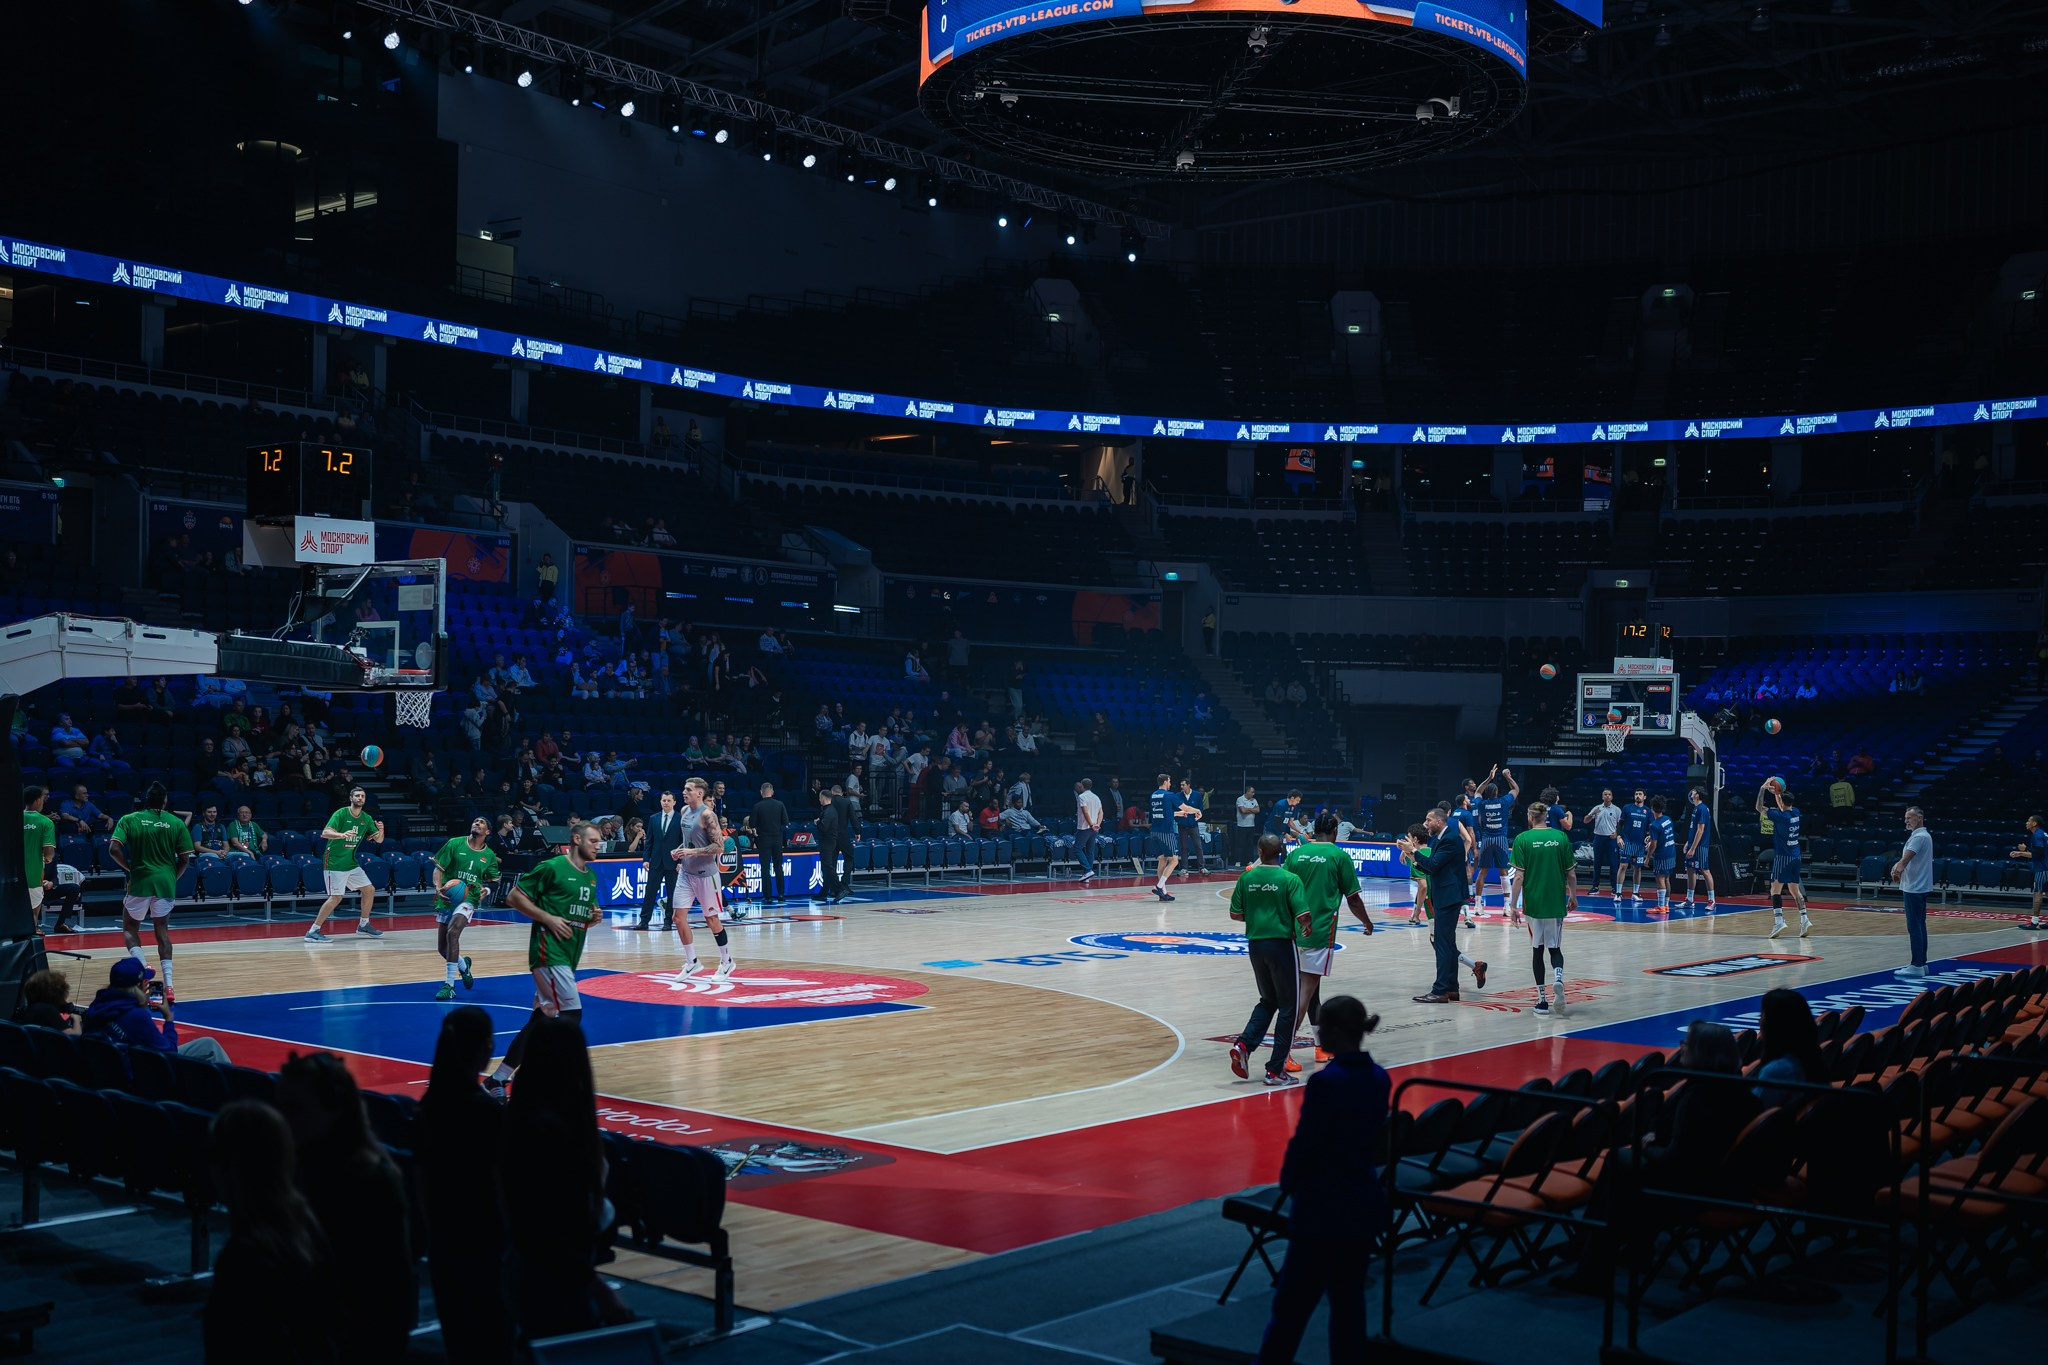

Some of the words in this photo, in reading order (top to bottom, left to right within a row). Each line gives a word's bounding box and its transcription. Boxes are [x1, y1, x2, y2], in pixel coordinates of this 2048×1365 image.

[940, 14, 947, 33] 0
[965, 0, 1114, 43] TICKETS.VTB-LEAGUE.COM
[13, 242, 65, 261] МОСКОВСКИЙ
[13, 254, 37, 267] СПОРТ
[134, 265, 181, 283] МОСКОВСКИЙ
[133, 276, 156, 289] СПОРТ
[244, 286, 288, 304] МОСКОВСКИЙ
[244, 297, 265, 309] СПОРТ
[346, 305, 387, 322] МОСКОВСКИЙ
[346, 316, 365, 327] СПОРТ
[440, 323, 478, 339] МОСКОВСКИЙ
[440, 333, 457, 344] СПОРТ
[527, 339, 562, 354] МОСКОВСКИЙ
[527, 349, 543, 360] СПОРТ
[608, 355, 641, 369] МОСКОВСКИЙ
[608, 364, 624, 374] СПОРТ
[684, 369, 715, 382] МОСКОВСКИЙ
[684, 378, 699, 388] СПОРТ
[755, 382, 791, 394] МОСКОВСКИЙ
[755, 391, 771, 400] СПОРТ
[839, 392, 874, 403] МОСКОВСКИЙ
[839, 401, 855, 409] СПОРТ
[920, 401, 953, 412] МОСКОВСКИЙ
[1993, 398, 2036, 410] МОСКОВСКИЙ
[920, 410, 935, 418] СПОРТ
[1892, 407, 1933, 418] МОСКОВСКИЙ
[1992, 411, 2012, 419] СПОРТ
[1083, 415, 1120, 424] МОСКОВСКИЙ
[1702, 419, 1742, 429] МОСКОВСКИЙ
[1797, 412, 1837, 425] МОСКОВСКИЙ
[1892, 418, 1911, 426] СПОРТ
[1083, 423, 1100, 431] СПОРТ
[1168, 420, 1204, 429] МОСКОВСКИЙ
[1252, 423, 1289, 432] МОСКОВСКИЙ
[1340, 423, 1378, 433] МОСКОВСКИЙ
[1429, 424, 1466, 434] МОСКОВСКИЙ
[1518, 425, 1556, 434] МОСКОВСКИЙ
[1608, 422, 1648, 433] МОСКОВСКИЙ
[1797, 425, 1815, 433] СПОРТ
[1168, 428, 1184, 436] СПОРТ
[260, 449, 283, 472] 7.2
[320, 449, 353, 475] 7.2
[320, 531, 369, 545] МОСКОВСКИЙ
[320, 543, 344, 554] СПОРТ
[1623, 625, 1647, 637] 17.2
[468, 860, 474, 871] 1
[457, 871, 478, 883] UNICS
[578, 886, 590, 901] 13
